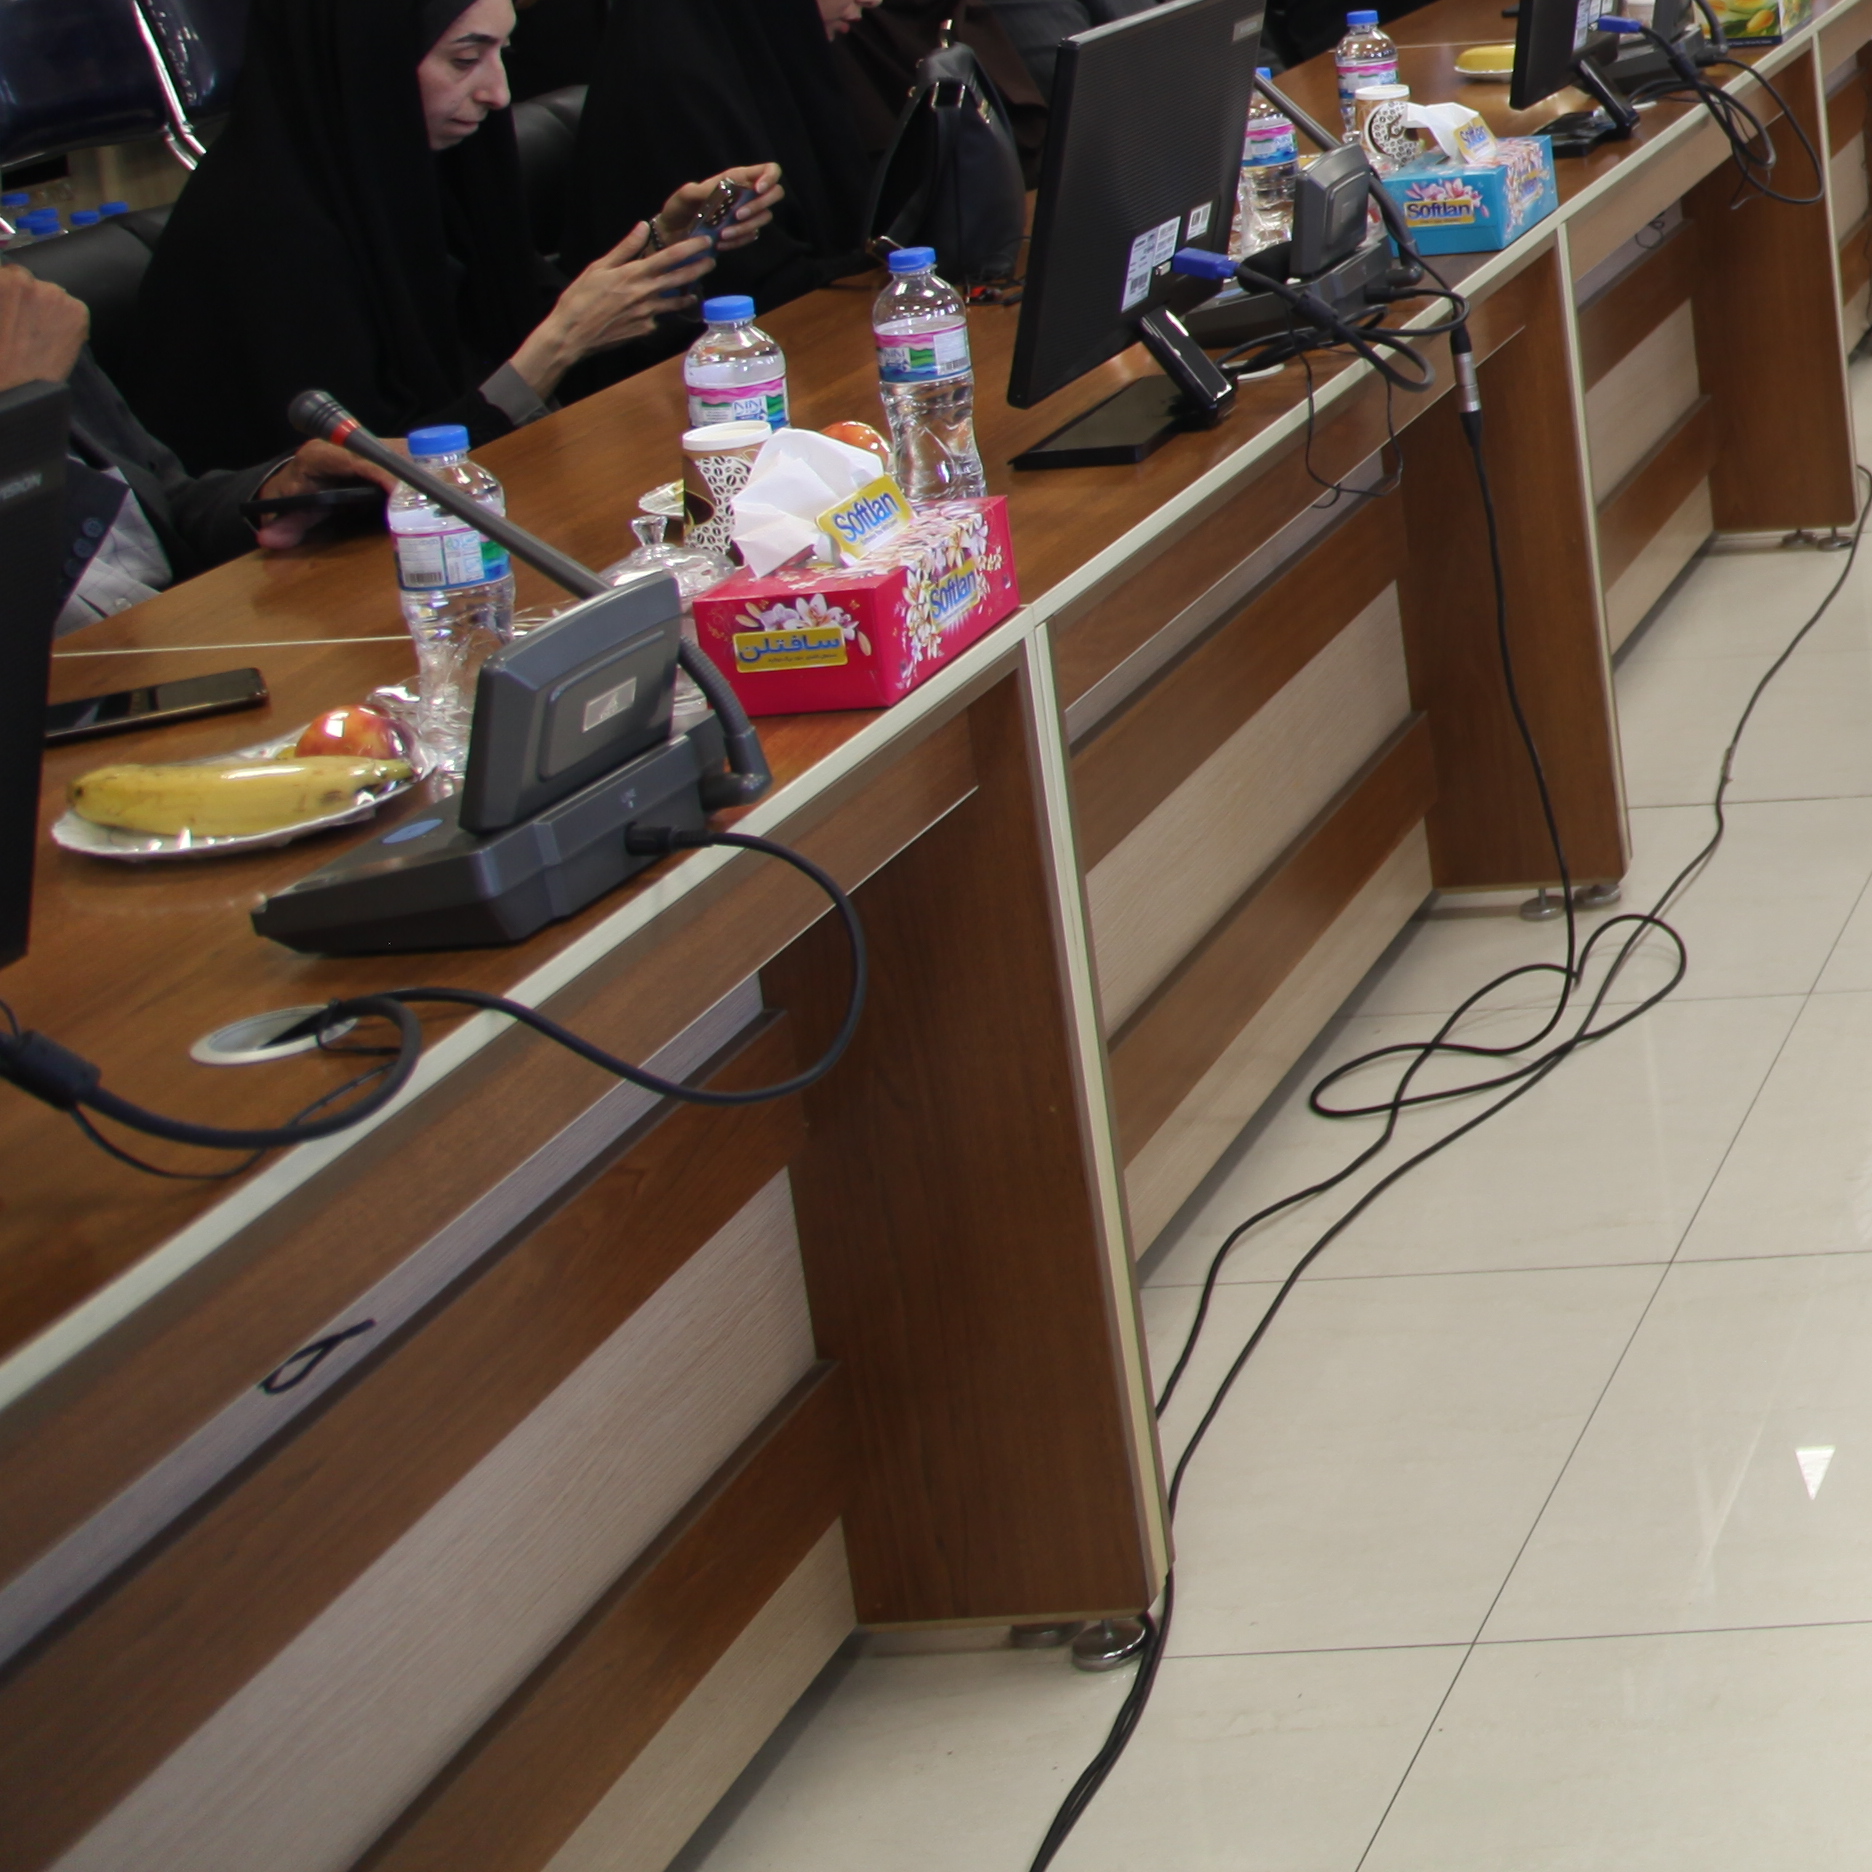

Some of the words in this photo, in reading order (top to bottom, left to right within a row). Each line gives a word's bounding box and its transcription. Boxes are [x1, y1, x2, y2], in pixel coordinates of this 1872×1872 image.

[1407, 201, 1470, 220] Softlan
[833, 492, 900, 544] Softlan
[930, 568, 979, 620] Softlan
[739, 633, 842, 664] سافتلن
